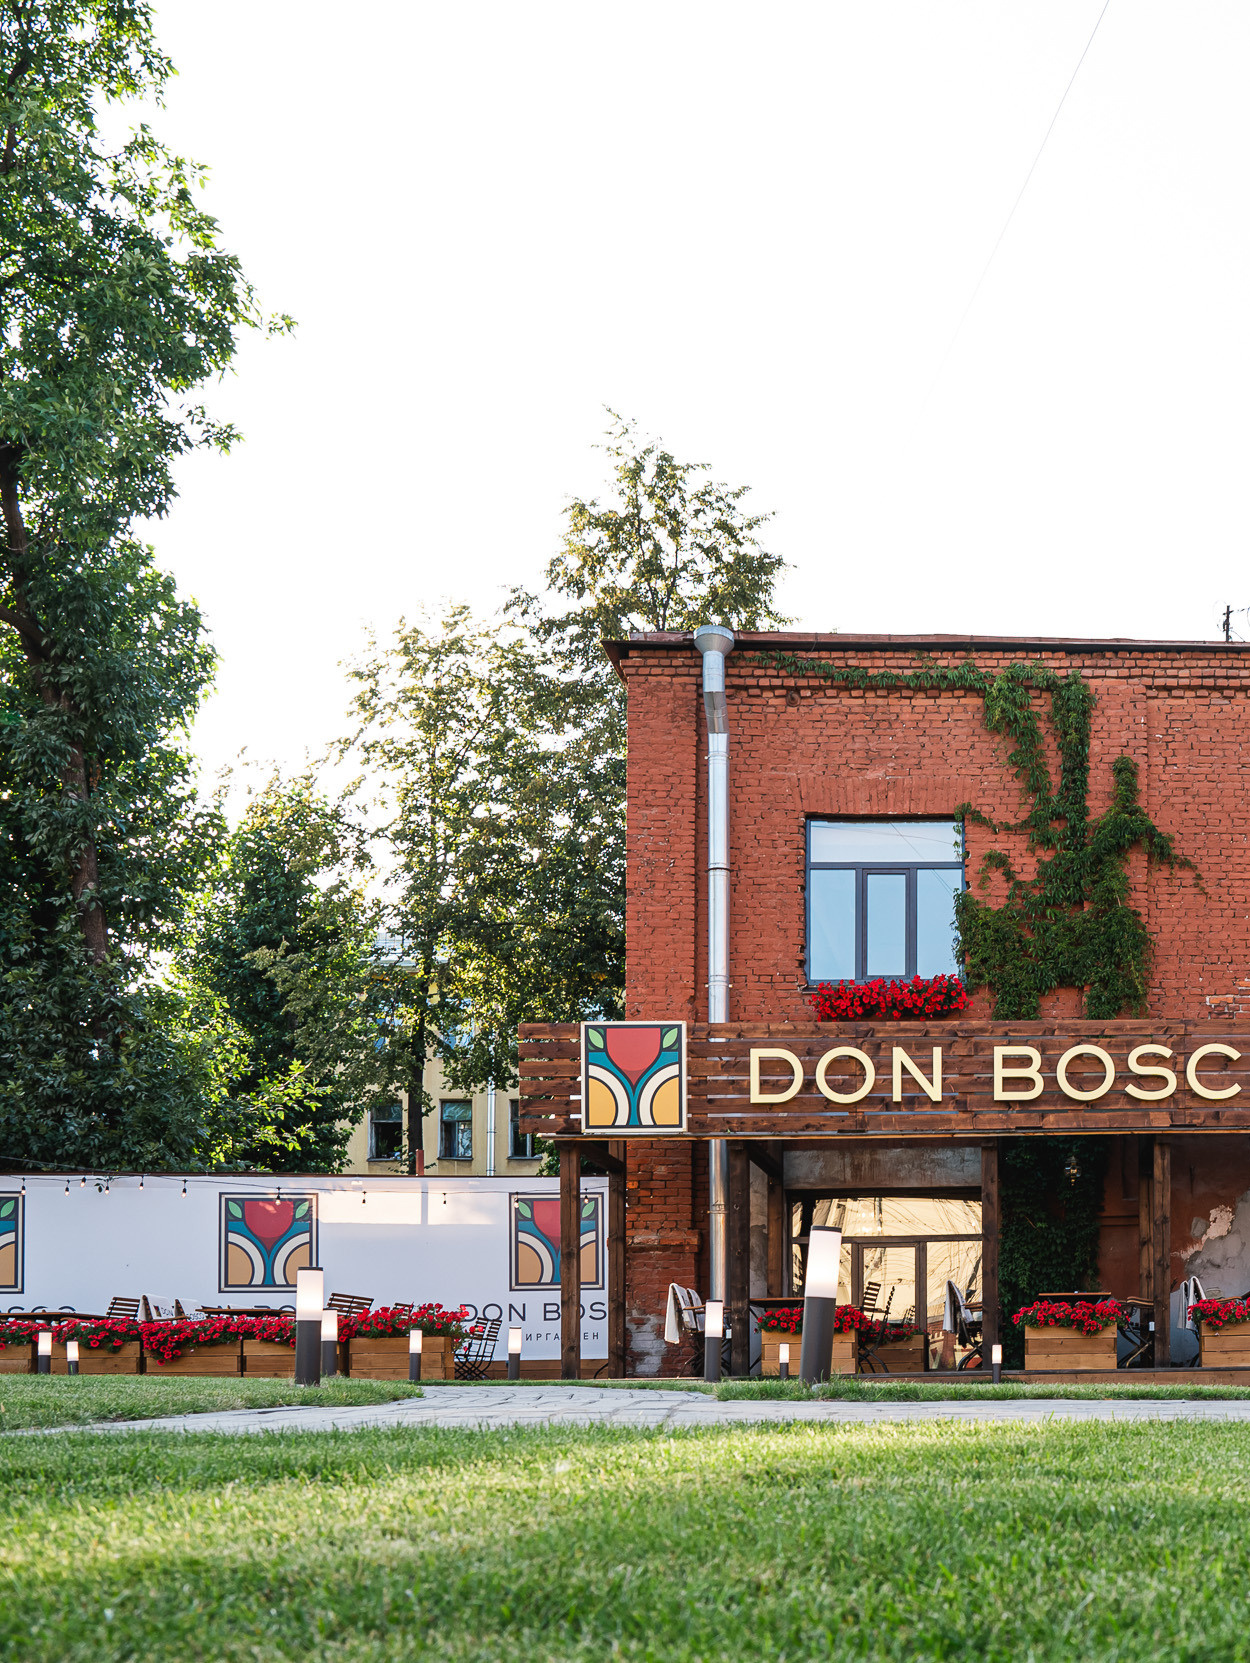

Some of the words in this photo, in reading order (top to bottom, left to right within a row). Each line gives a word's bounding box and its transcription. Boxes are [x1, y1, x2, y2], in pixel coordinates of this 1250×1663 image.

[749, 1046, 943, 1104] DON
[460, 1303, 526, 1322] DON
[543, 1302, 607, 1321] BS
